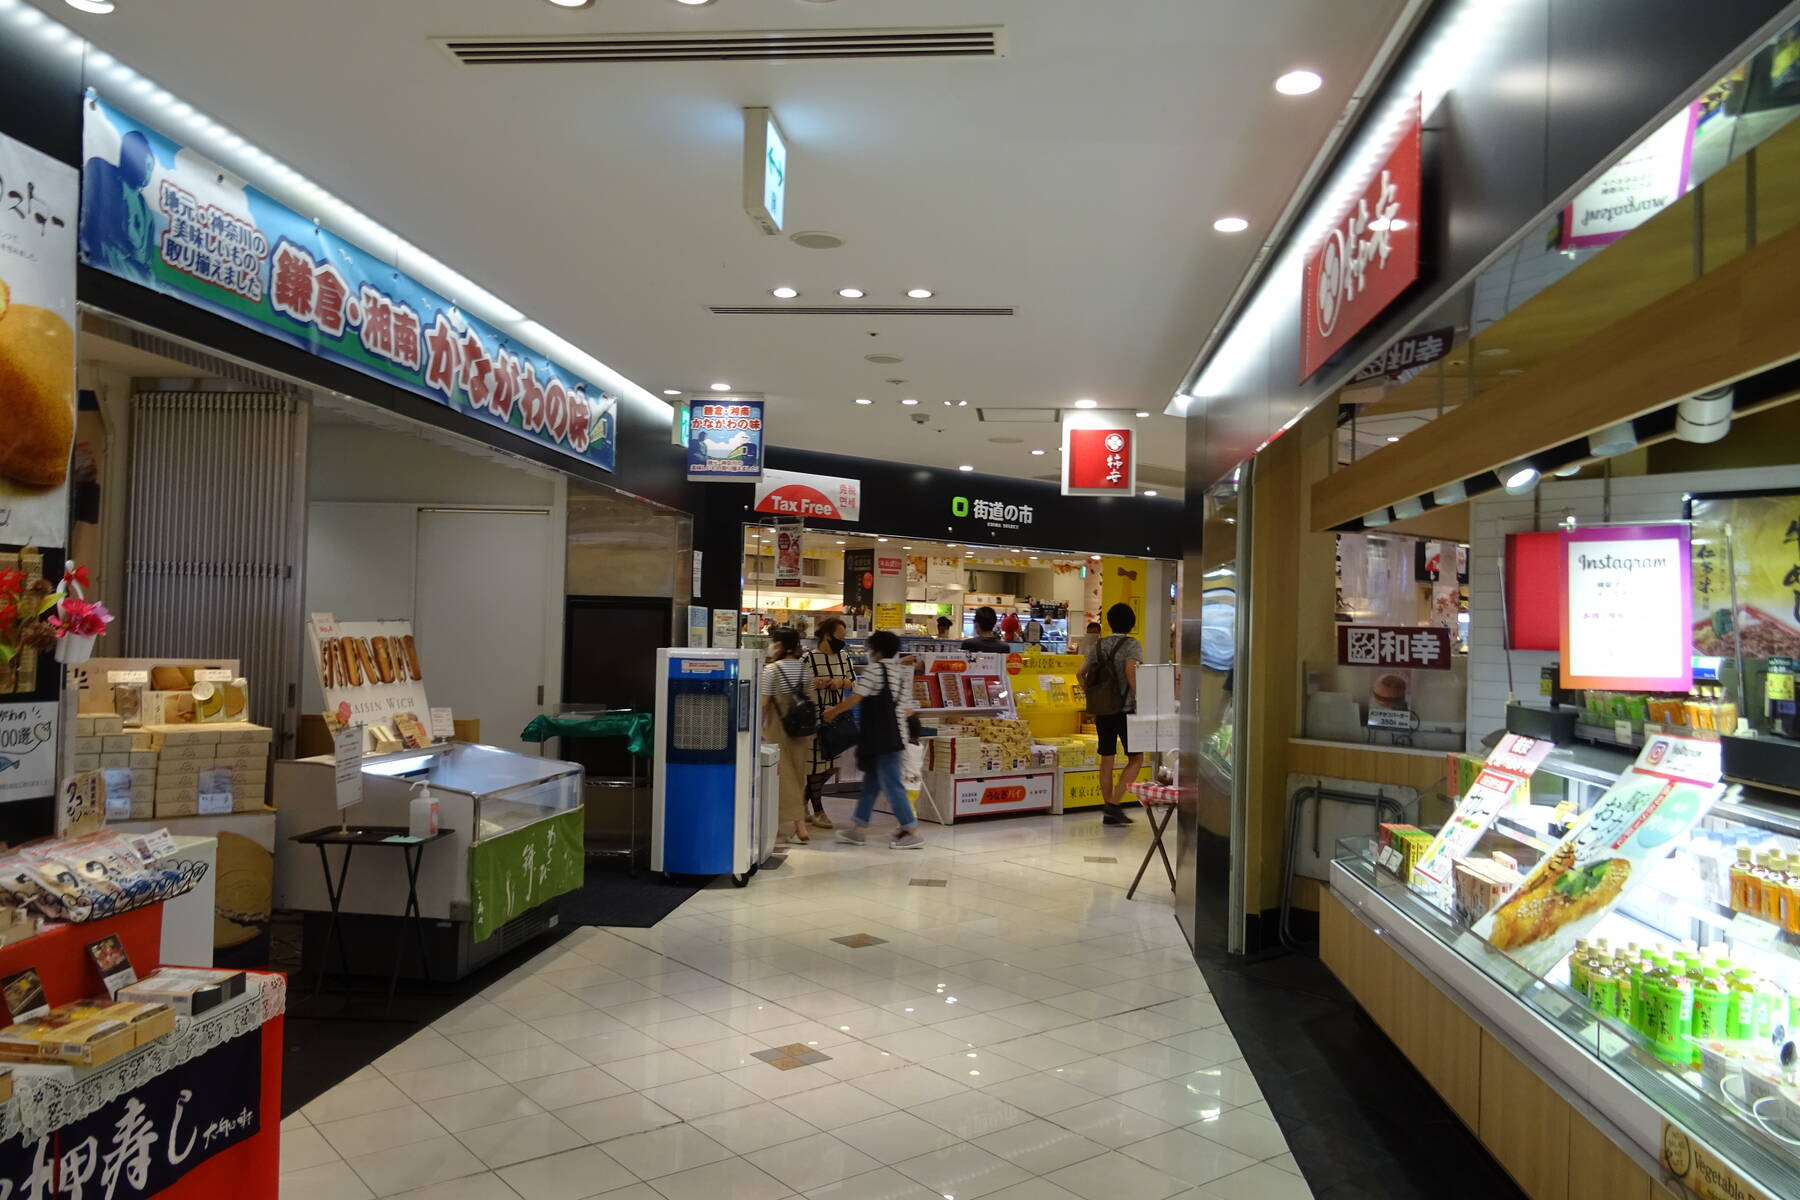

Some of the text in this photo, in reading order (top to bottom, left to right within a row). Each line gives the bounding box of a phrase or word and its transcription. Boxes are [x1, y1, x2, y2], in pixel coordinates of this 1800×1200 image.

[172, 218, 257, 272] 美味しいもの
[165, 238, 260, 297] 取り揃えました
[274, 242, 592, 450] 鎌倉・湘南 かながわの味
[692, 418, 761, 430] かながわの味
[771, 495, 833, 516] Tax Free
[973, 499, 1034, 524] 街道の市
[1578, 553, 1667, 574] Instagram
[1380, 631, 1440, 665] 和幸
[353, 701, 383, 713] AISIN
